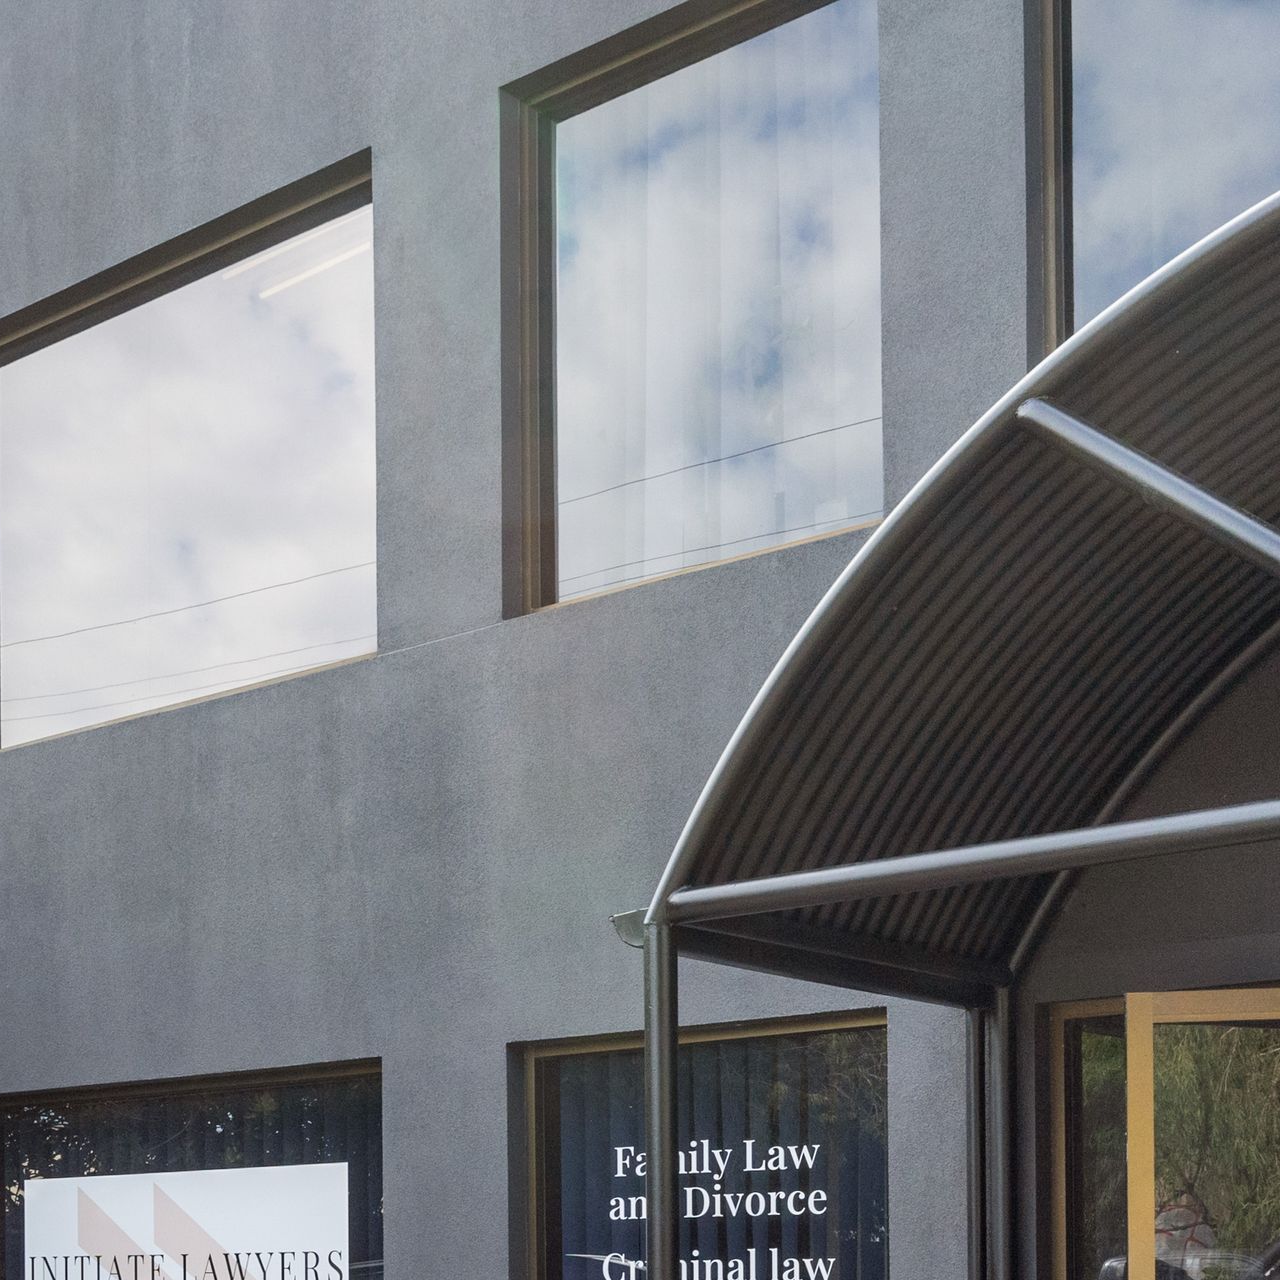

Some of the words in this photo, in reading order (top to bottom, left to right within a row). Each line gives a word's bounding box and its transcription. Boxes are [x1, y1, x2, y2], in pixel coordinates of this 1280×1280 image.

[614, 1139, 732, 1180] Faily
[743, 1139, 820, 1172] Law
[609, 1196, 648, 1220] an
[683, 1183, 827, 1219] Divorce
